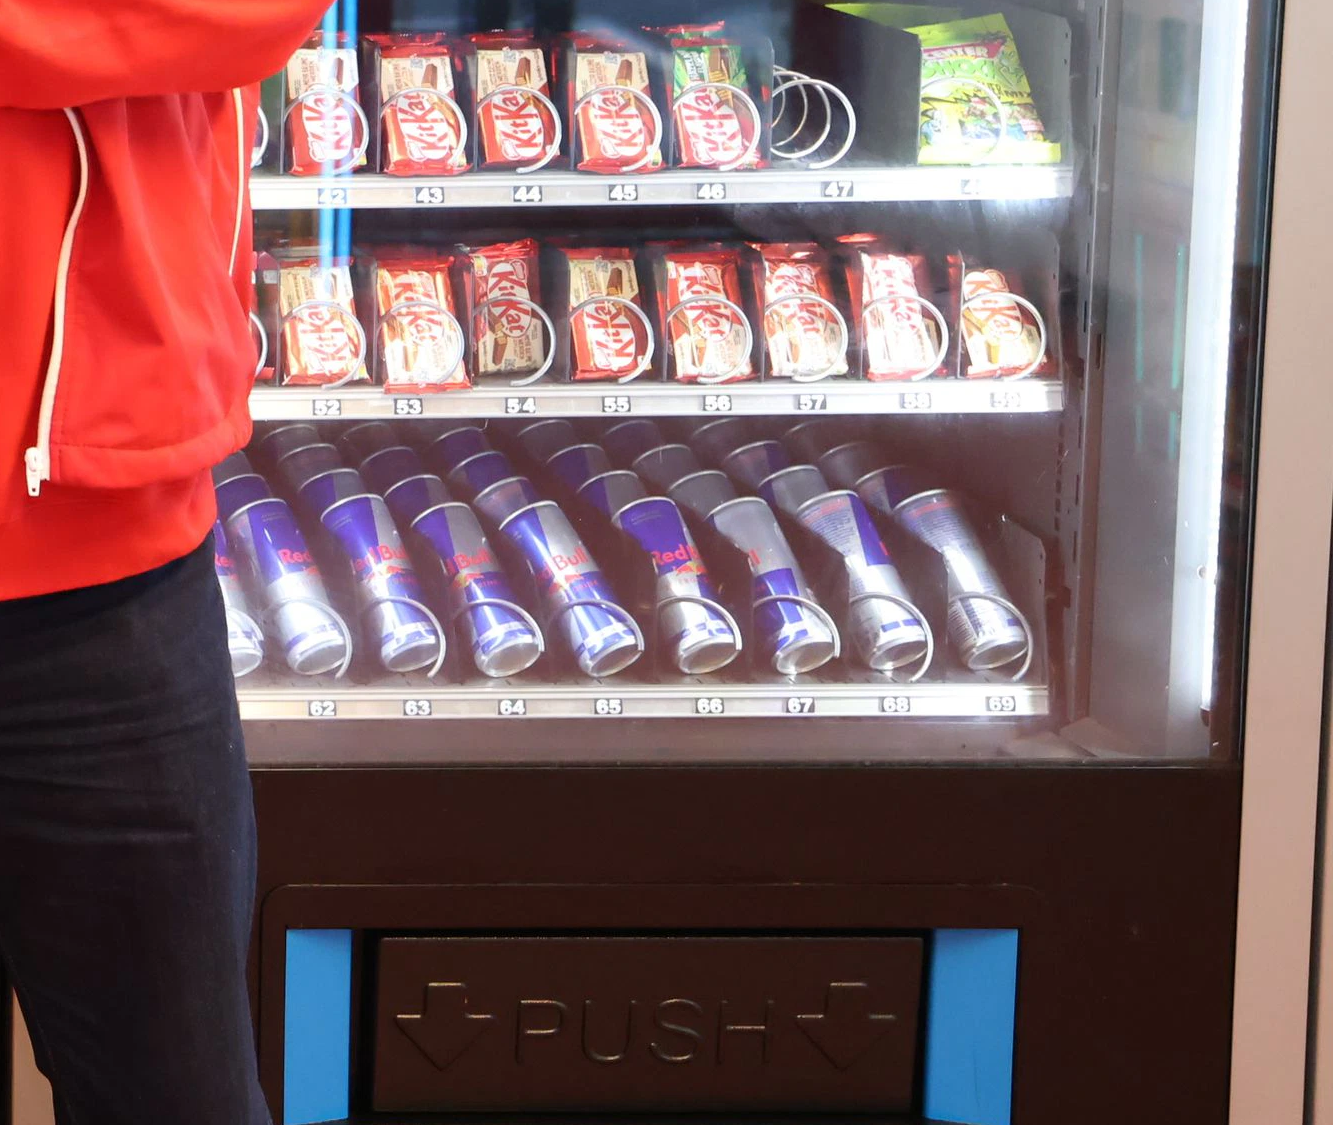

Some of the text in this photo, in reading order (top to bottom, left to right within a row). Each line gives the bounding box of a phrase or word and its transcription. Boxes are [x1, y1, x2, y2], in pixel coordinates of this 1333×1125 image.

[319, 189, 346, 203] 42
[416, 188, 443, 202] 43
[514, 187, 542, 201] 44
[610, 185, 636, 200] 45
[698, 184, 724, 198] 46
[825, 182, 852, 196] 47
[314, 401, 340, 415] 52
[396, 399, 421, 414] 53
[507, 399, 535, 412] 54
[604, 398, 629, 412] 55
[704, 397, 731, 410] 56
[799, 396, 826, 410] 57
[310, 701, 335, 715] 62
[405, 701, 430, 715] 63
[499, 700, 525, 714] 64
[596, 700, 621, 714] 65
[697, 699, 723, 713] 66
[788, 698, 813, 712] 67
[883, 697, 909, 711] 68
[988, 697, 1014, 711] 69
[514, 997, 774, 1064] PUSH
